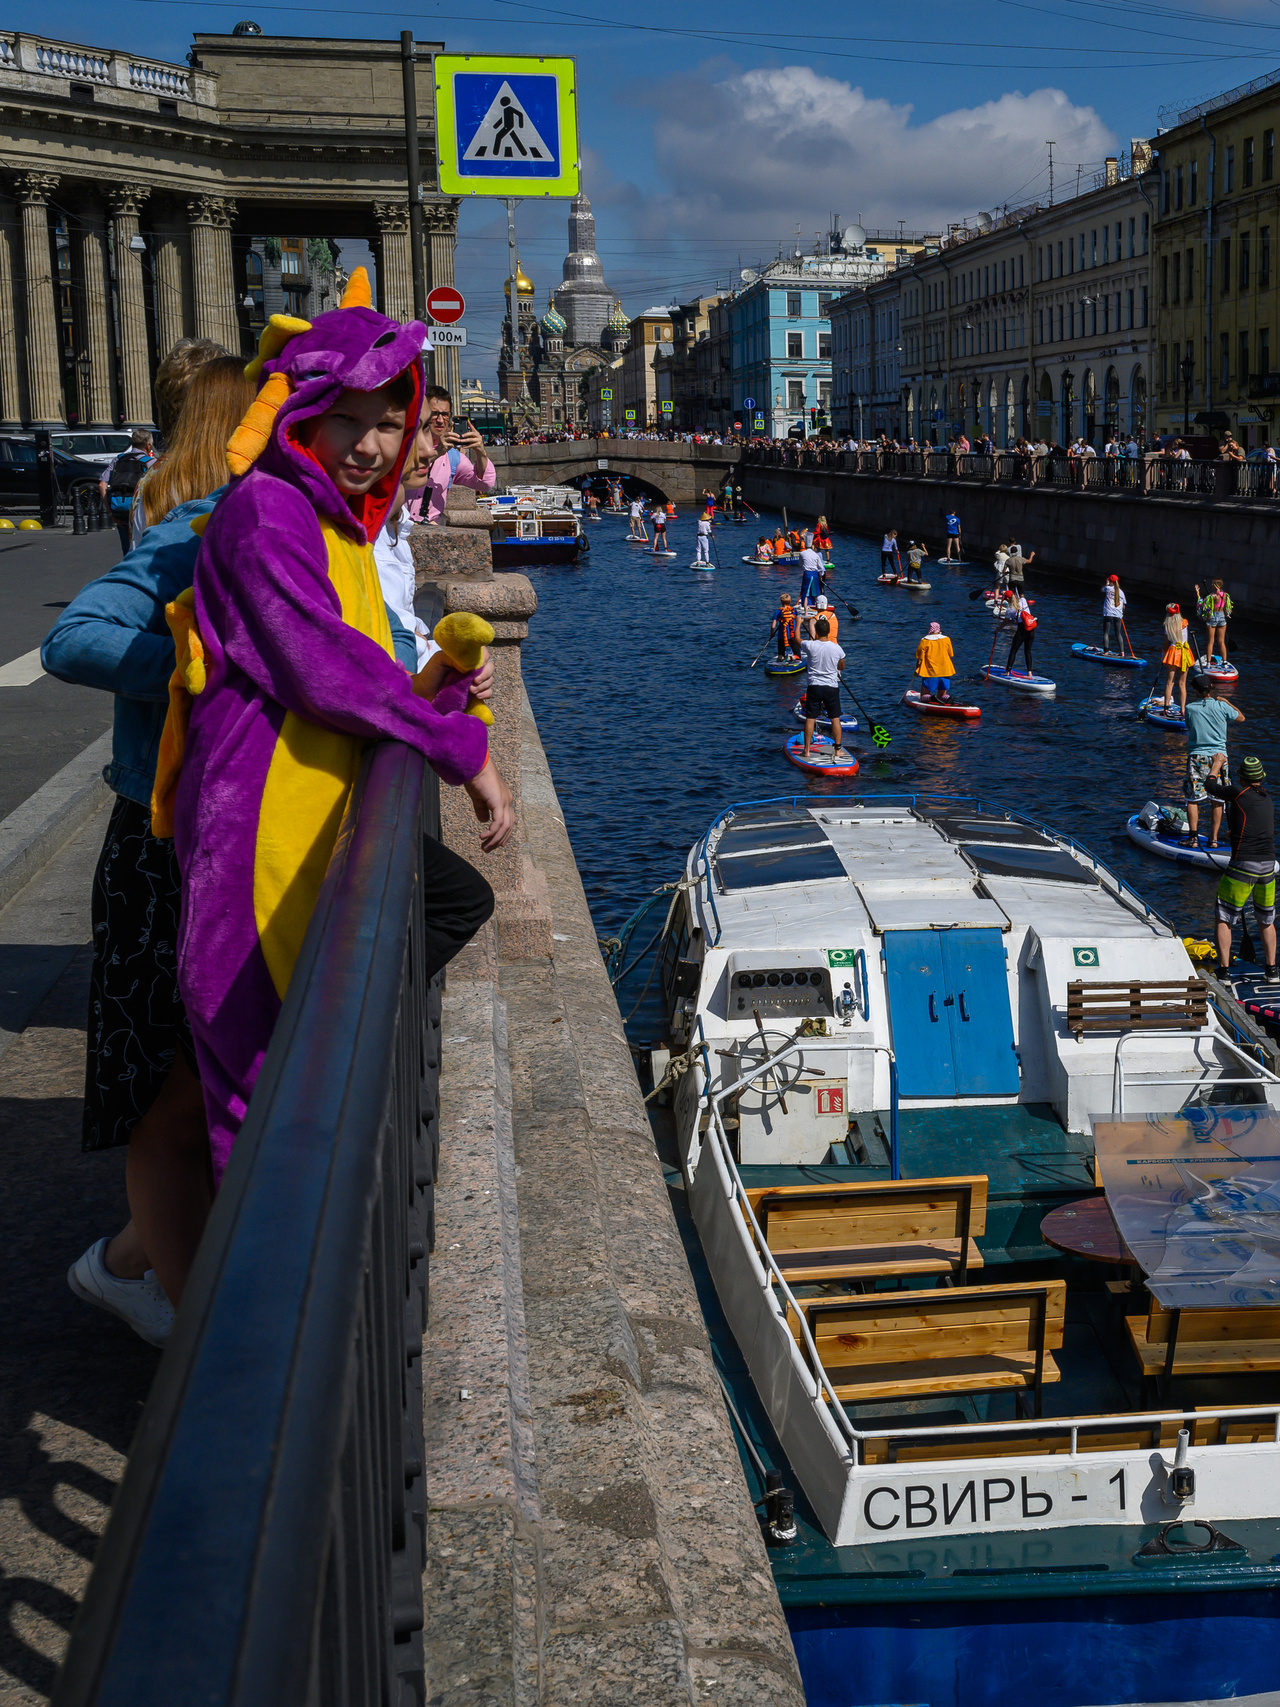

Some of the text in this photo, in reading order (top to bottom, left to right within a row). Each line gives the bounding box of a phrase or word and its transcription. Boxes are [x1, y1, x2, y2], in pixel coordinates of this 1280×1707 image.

[432, 331, 462, 342] 100м
[863, 1475, 1054, 1531] СВИРЬ
[1108, 1468, 1126, 1510] 1
